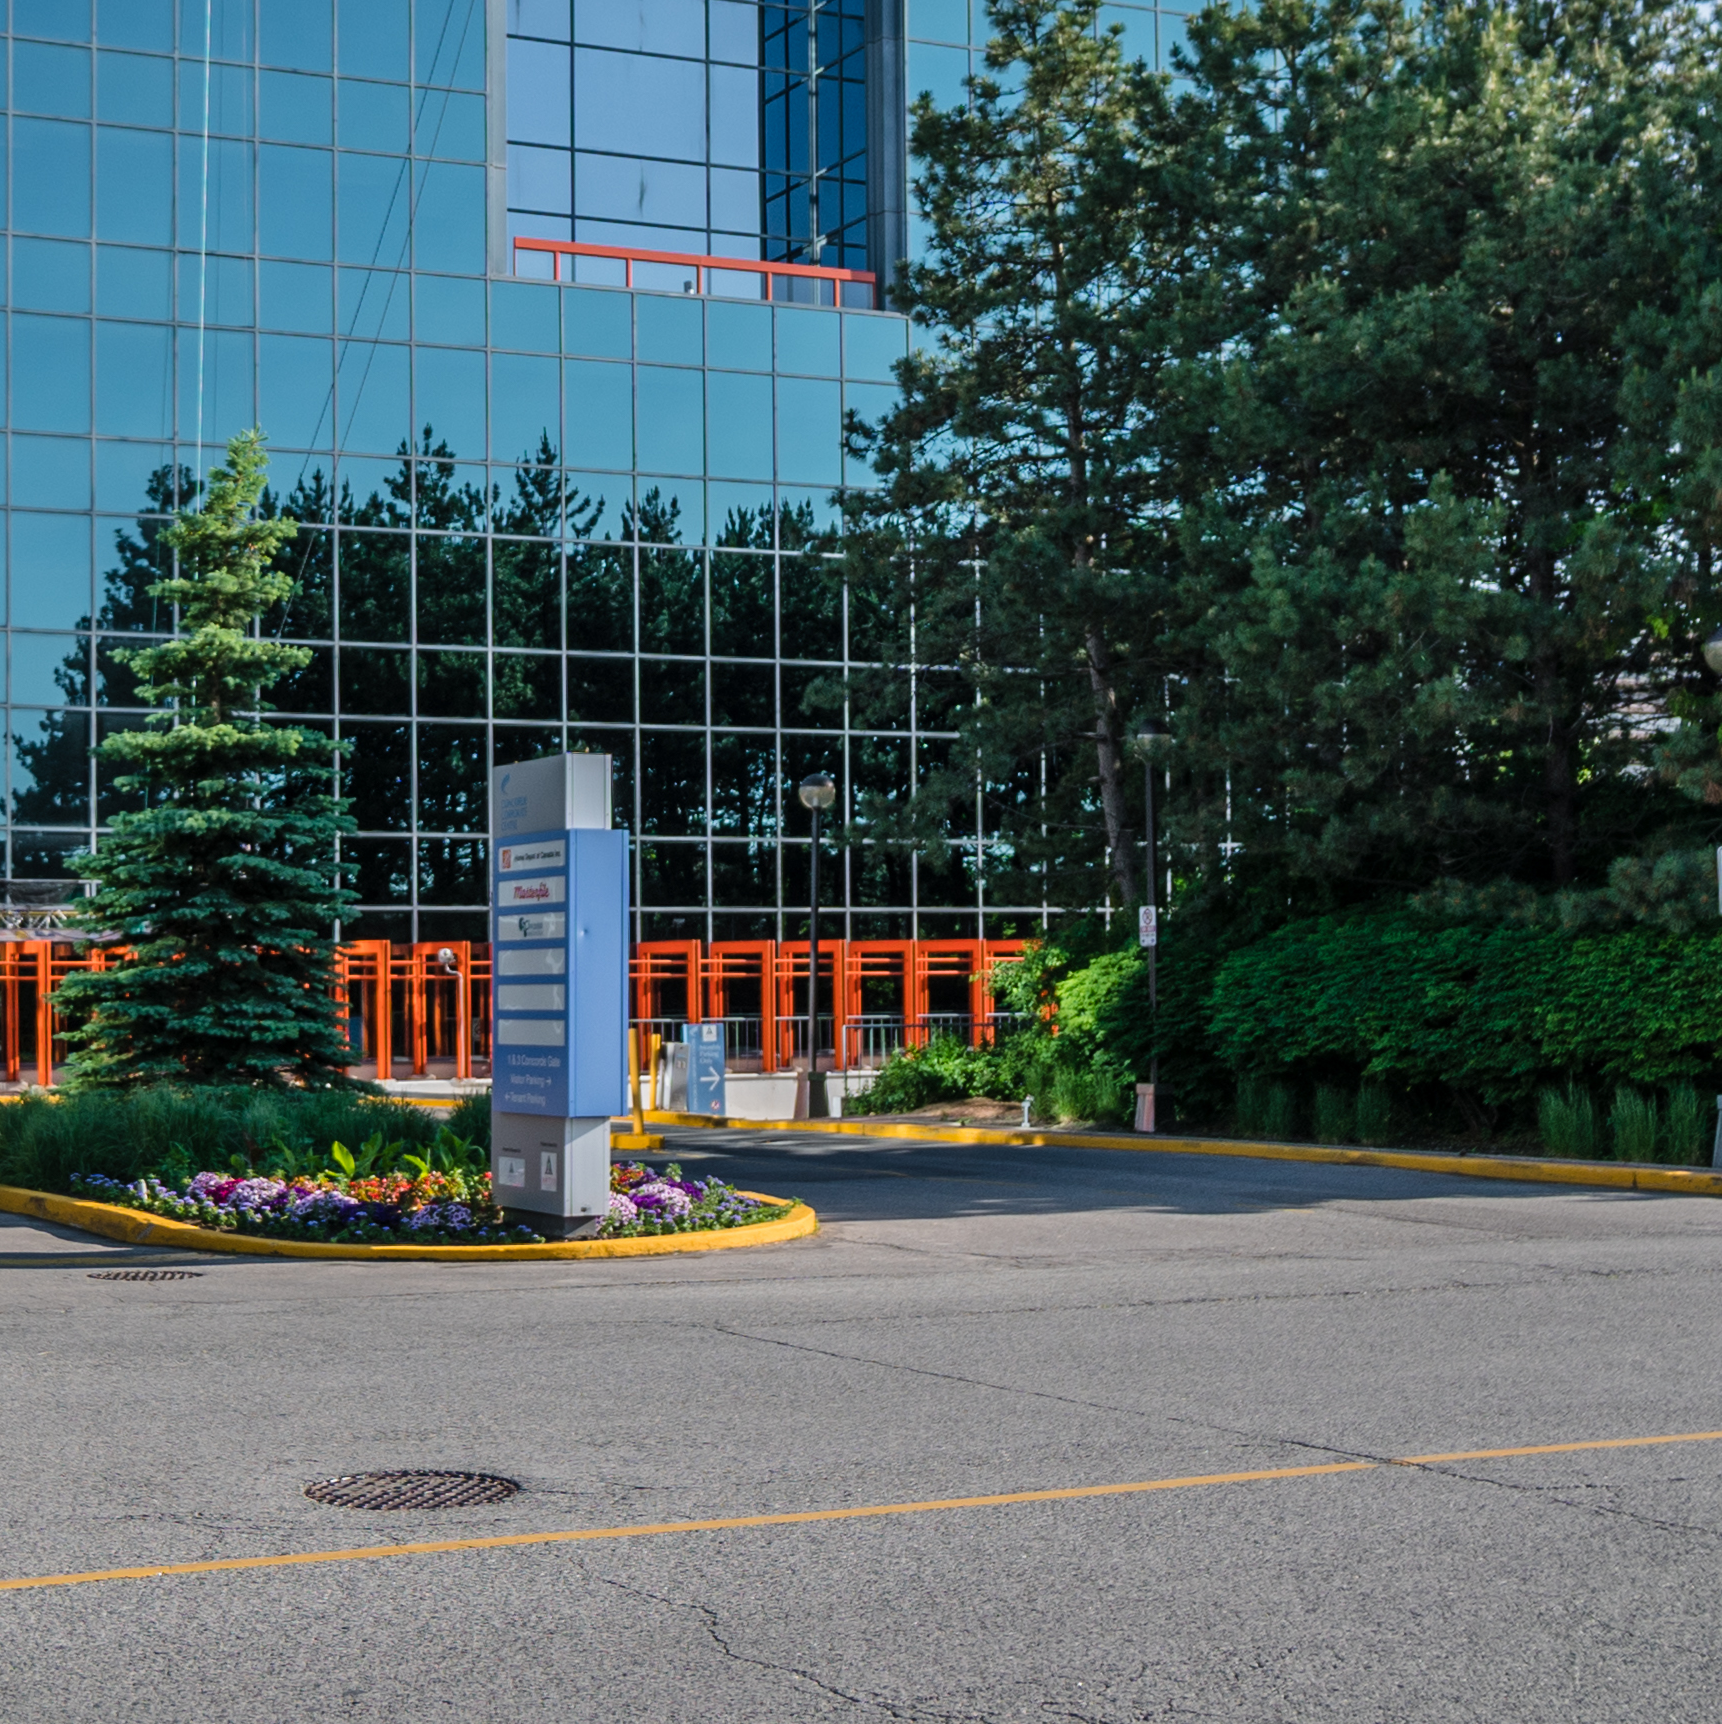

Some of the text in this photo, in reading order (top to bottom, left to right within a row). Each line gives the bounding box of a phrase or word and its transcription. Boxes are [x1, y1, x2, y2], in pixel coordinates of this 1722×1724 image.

[521, 1054, 547, 1067] Concorde
[548, 1055, 561, 1067] Gate
[525, 1074, 545, 1088] Parking
[525, 1092, 546, 1107] Parking
